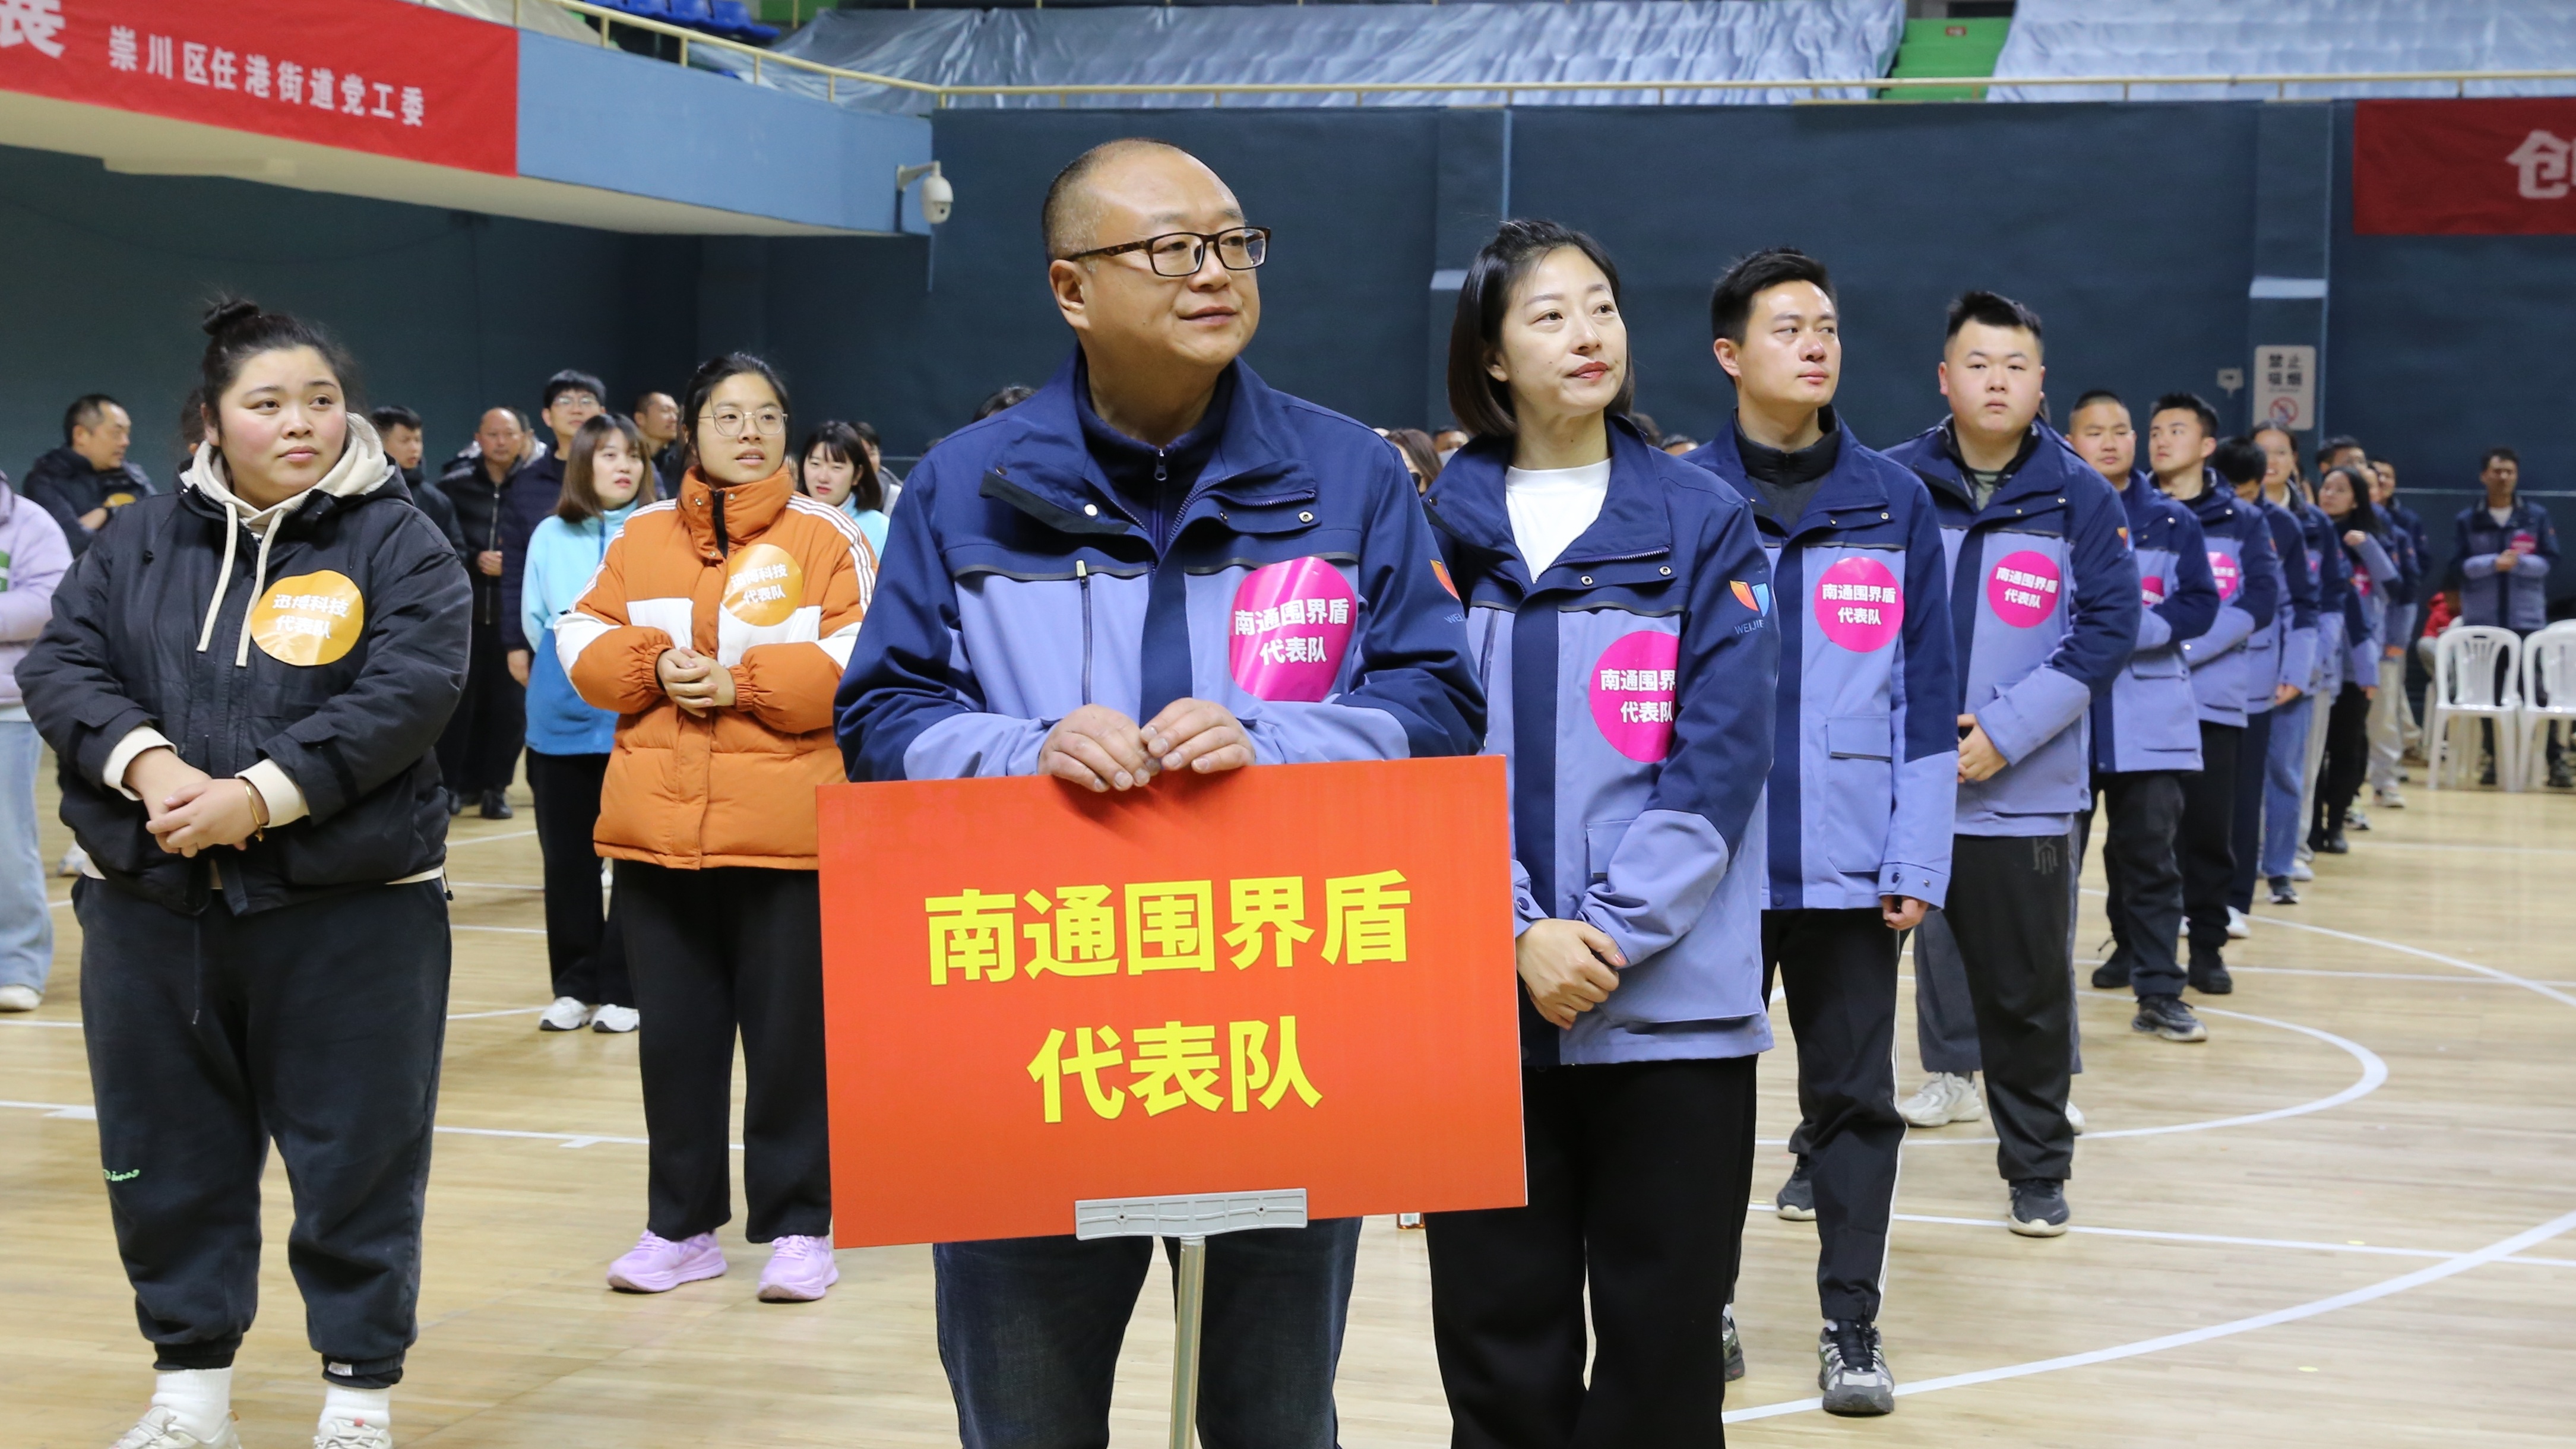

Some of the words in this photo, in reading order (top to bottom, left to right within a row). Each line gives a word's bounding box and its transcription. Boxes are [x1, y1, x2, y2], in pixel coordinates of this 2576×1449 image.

[109, 26, 424, 126] 崇川区任港街道党工委
[1996, 567, 2058, 594] 南通围界盾
[743, 584, 786, 605] 代表队
[1822, 583, 1896, 604] 南通围界盾
[2004, 588, 2041, 609] 代表队
[276, 615, 331, 639] 代表队
[1235, 597, 1350, 636] 南通围界盾
[1837, 607, 1882, 625] 代表队
[1259, 637, 1327, 666] 代表队
[1620, 701, 1673, 723] 代表队
[925, 869, 1412, 986] 南通围界盾
[1026, 1015, 1324, 1124] 代表队
